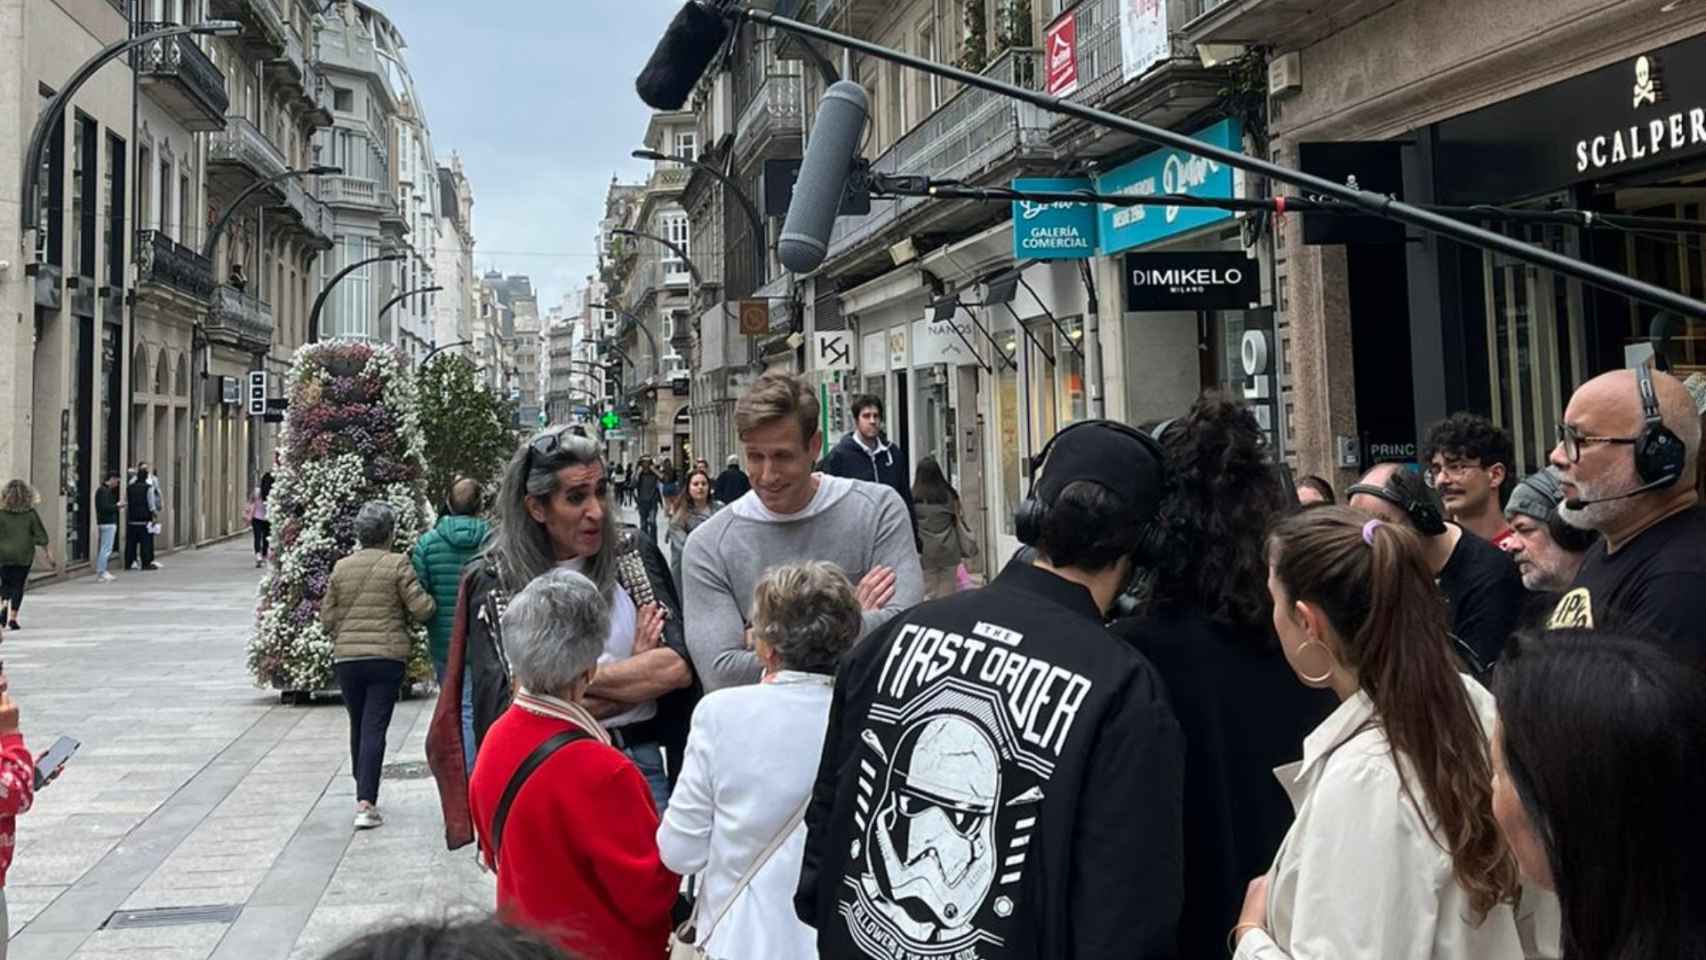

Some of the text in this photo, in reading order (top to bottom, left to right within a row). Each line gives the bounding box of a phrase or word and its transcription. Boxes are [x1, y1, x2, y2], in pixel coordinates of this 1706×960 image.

[1576, 107, 1706, 173] SCALPER
[1031, 225, 1079, 237] GALERÍA
[1022, 237, 1088, 249] COMERCIAL
[1132, 268, 1242, 287] DIMIKELO
[1169, 286, 1204, 294] MILANO
[984, 625, 1011, 642] THE
[877, 623, 1092, 756] FIRST ORDER
